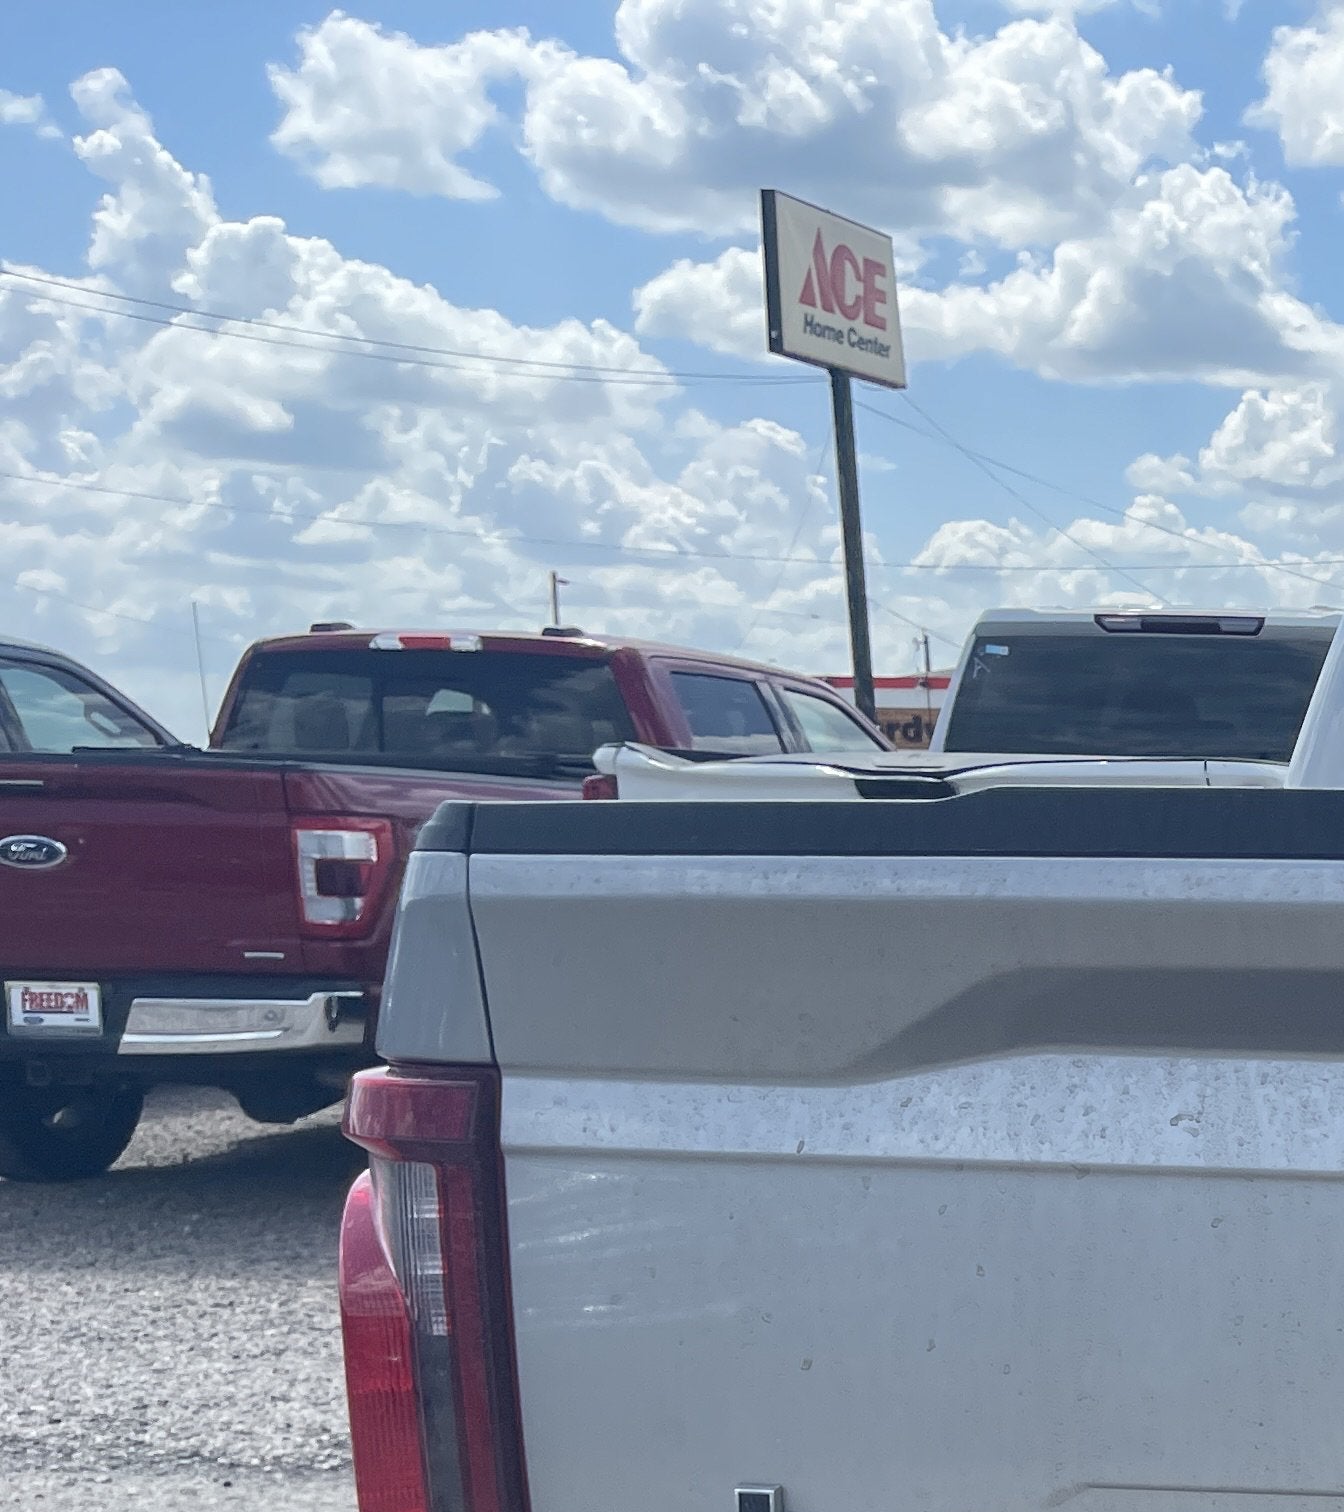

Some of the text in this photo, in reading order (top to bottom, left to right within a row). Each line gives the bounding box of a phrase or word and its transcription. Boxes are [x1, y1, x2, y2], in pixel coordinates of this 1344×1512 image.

[798, 227, 887, 331] ACE
[803, 313, 891, 359] Home Center
[8, 843, 48, 861] Ford
[21, 991, 89, 1013] FREEDOM
